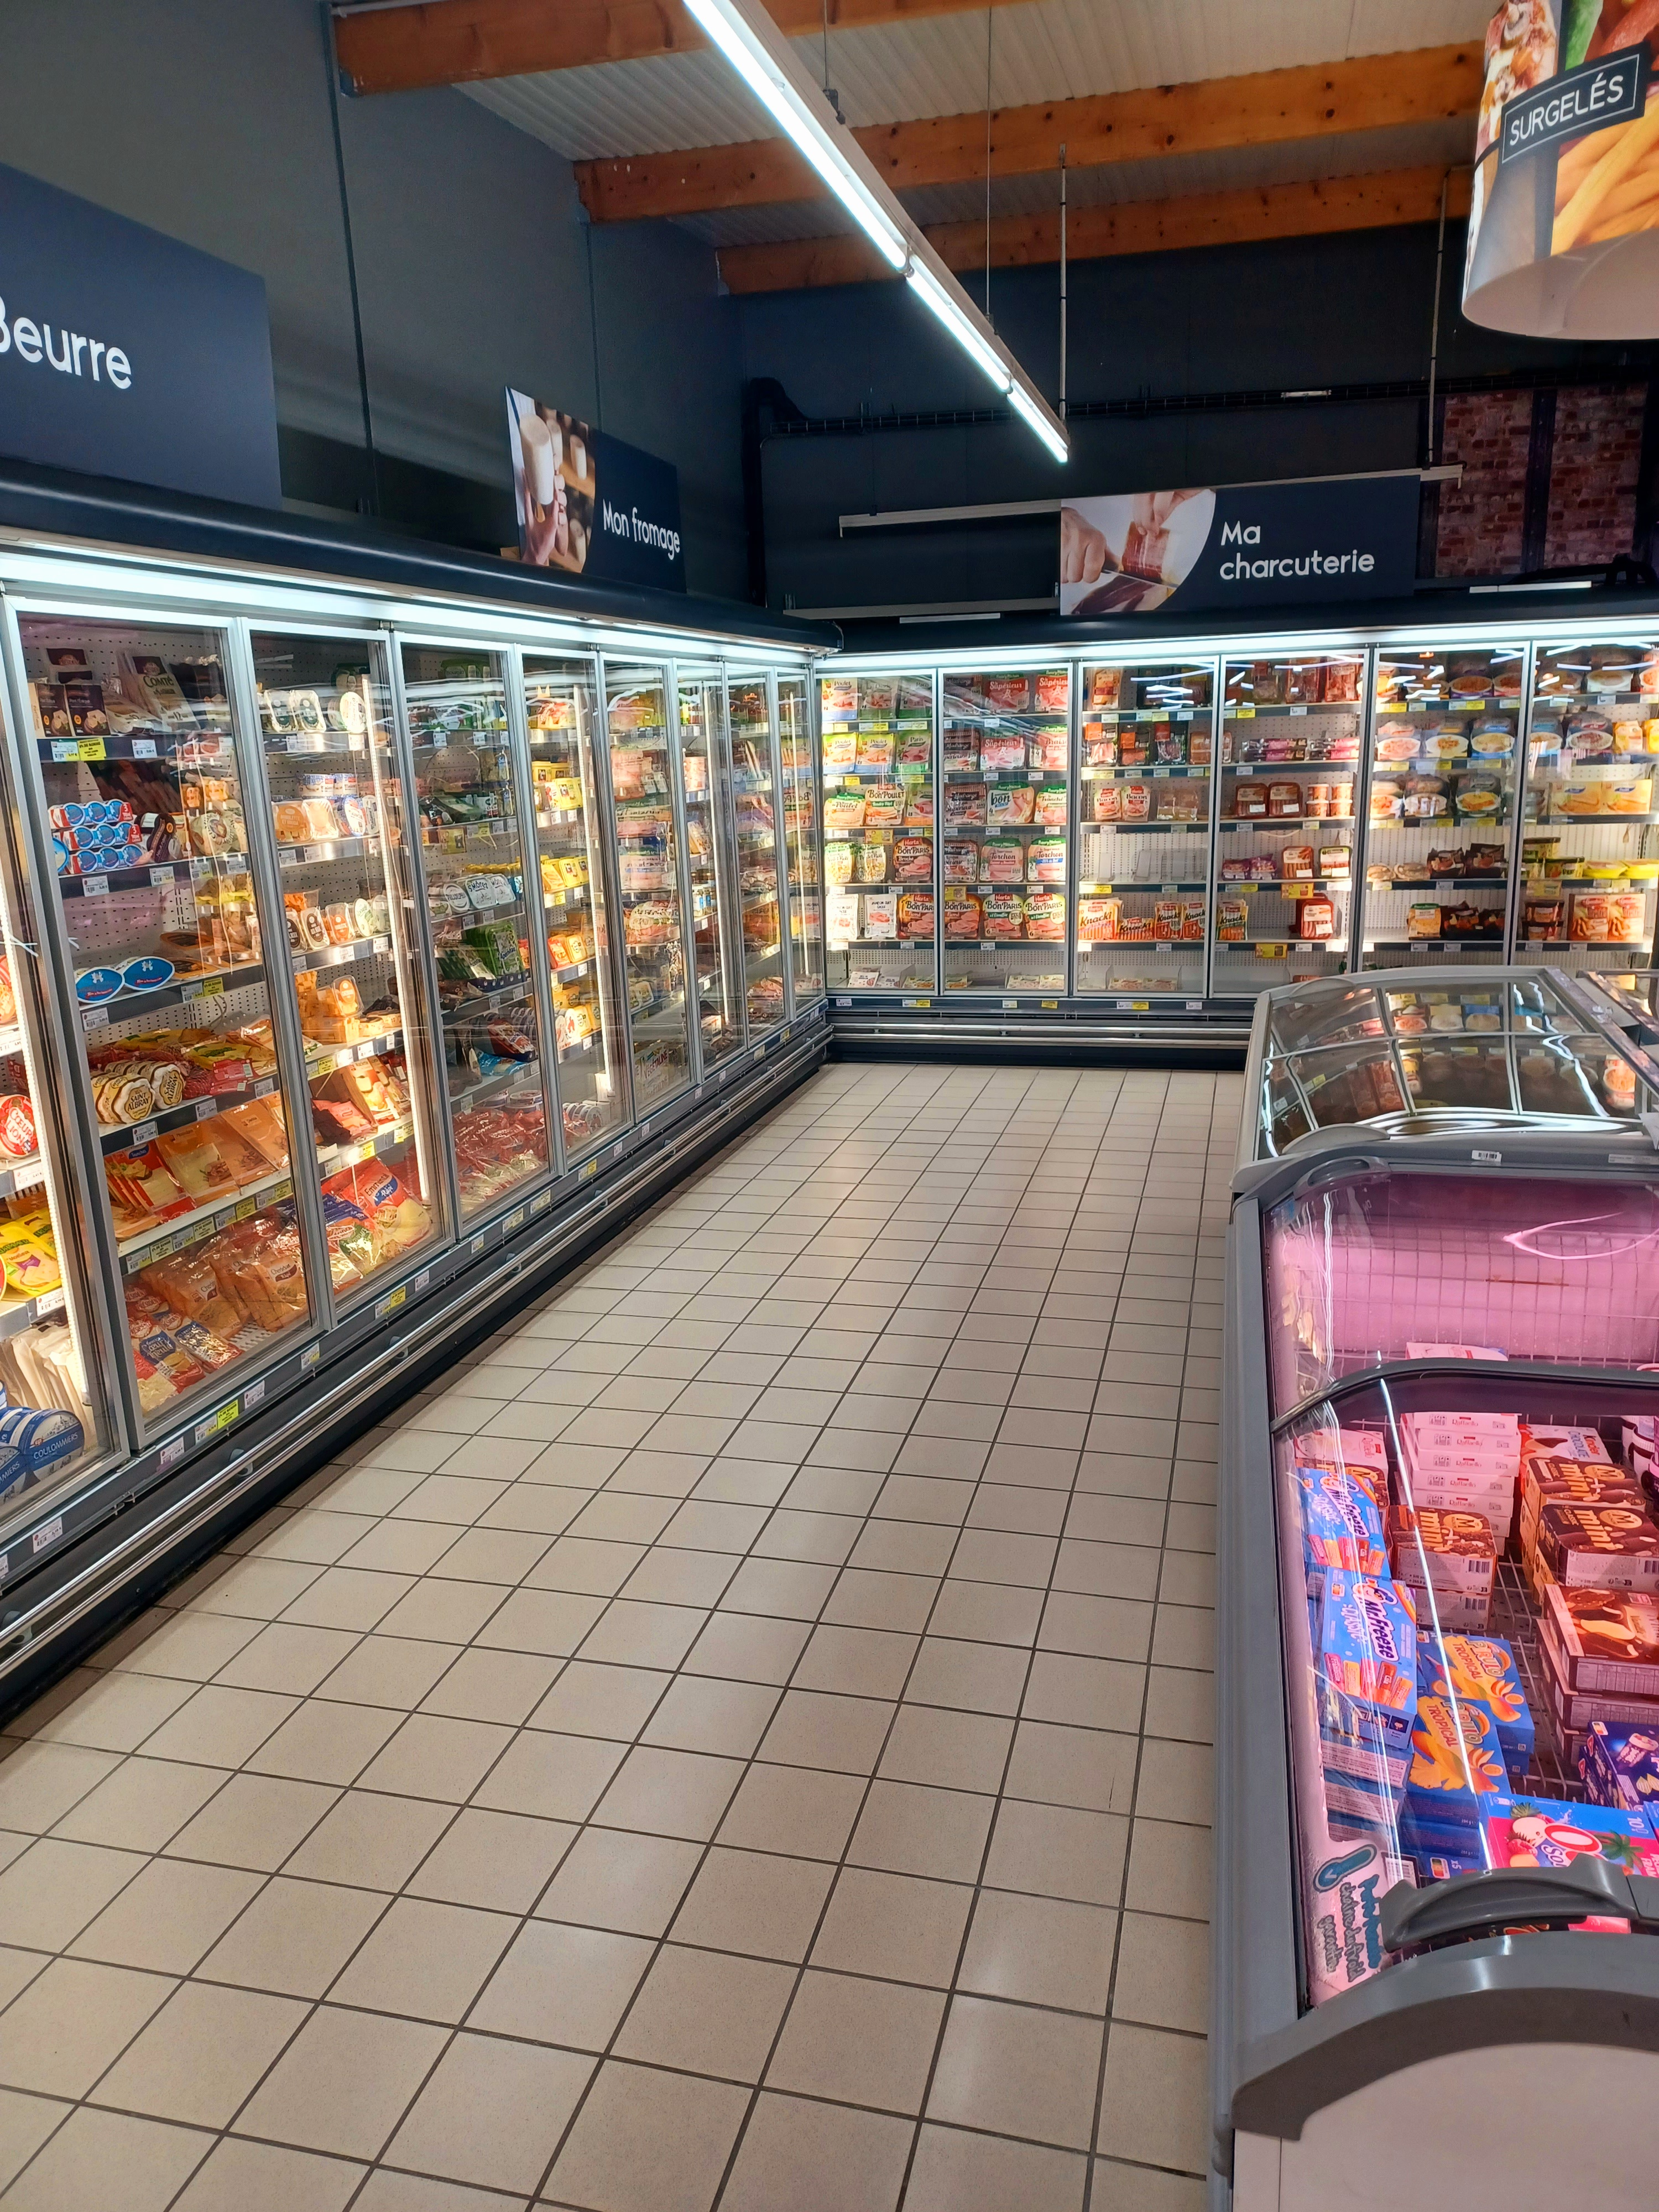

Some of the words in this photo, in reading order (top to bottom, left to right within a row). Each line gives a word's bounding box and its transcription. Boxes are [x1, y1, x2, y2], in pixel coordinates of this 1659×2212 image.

[1510, 74, 1624, 145] SURGELÉS
[0, 296, 132, 389] Beurre
[603, 499, 629, 538] Mon
[632, 506, 681, 560] fromage
[1221, 521, 1261, 546] Ma
[1220, 550, 1374, 581] charcuterie
[990, 681, 1022, 690] Supérieur
[1039, 677, 1068, 686] Supérieu
[984, 739, 1018, 748] Supérieur
[991, 792, 1011, 806] bon
[1001, 901, 1022, 910] PARIS
[1042, 901, 1063, 911] PARIS
[1080, 912, 1112, 926] Knacki
[1157, 912, 1181, 922] Knacki
[1185, 909, 1205, 921] Knack
[1220, 914, 1245, 924] Knacki
[1120, 922, 1151, 932] Knacki
[127, 1097, 151, 1111] ALBRAY
[131, 1092, 147, 1103] SAINT
[6, 1120, 24, 1144] LION
[364, 1173, 389, 1196] Emmental
[34, 1433, 78, 1459] COULOMMIERS
[1449, 1499, 1475, 1508] Raffaello
[1453, 1643, 1483, 1679] TROPICAL
[1427, 1704, 1459, 1747] TROPICAL
